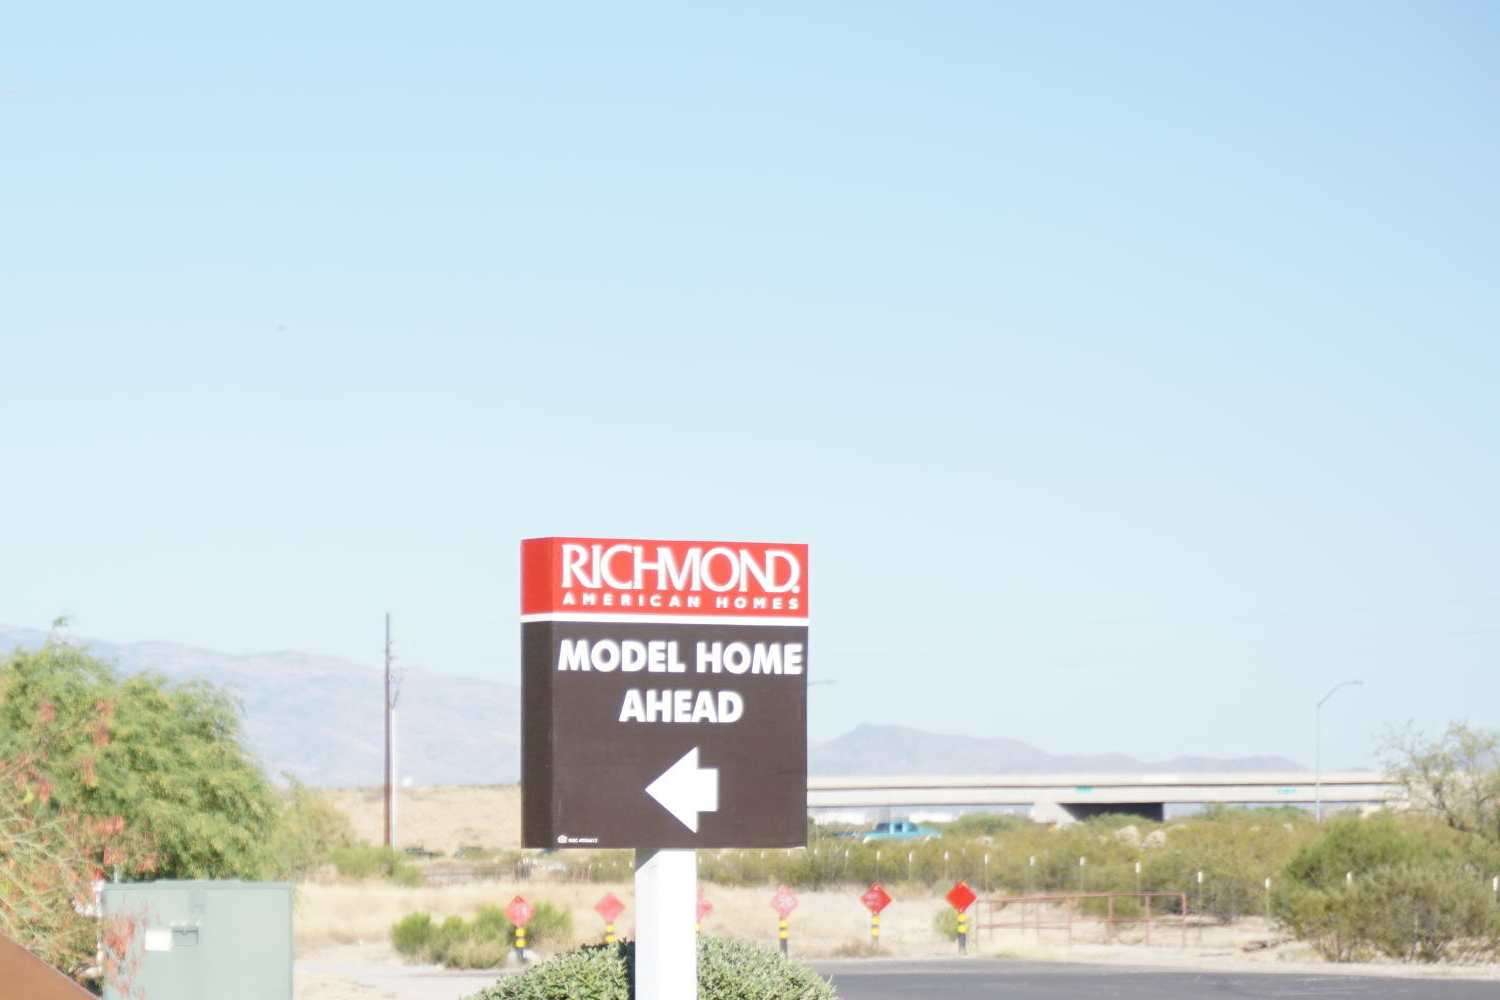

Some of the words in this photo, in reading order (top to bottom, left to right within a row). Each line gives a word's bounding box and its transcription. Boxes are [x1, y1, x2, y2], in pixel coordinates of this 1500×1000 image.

[562, 593, 701, 608] AMERICAN
[716, 596, 800, 610] HOMES
[557, 639, 686, 674] MODEL
[696, 641, 804, 675] HOME
[618, 689, 744, 723] AHEAD
